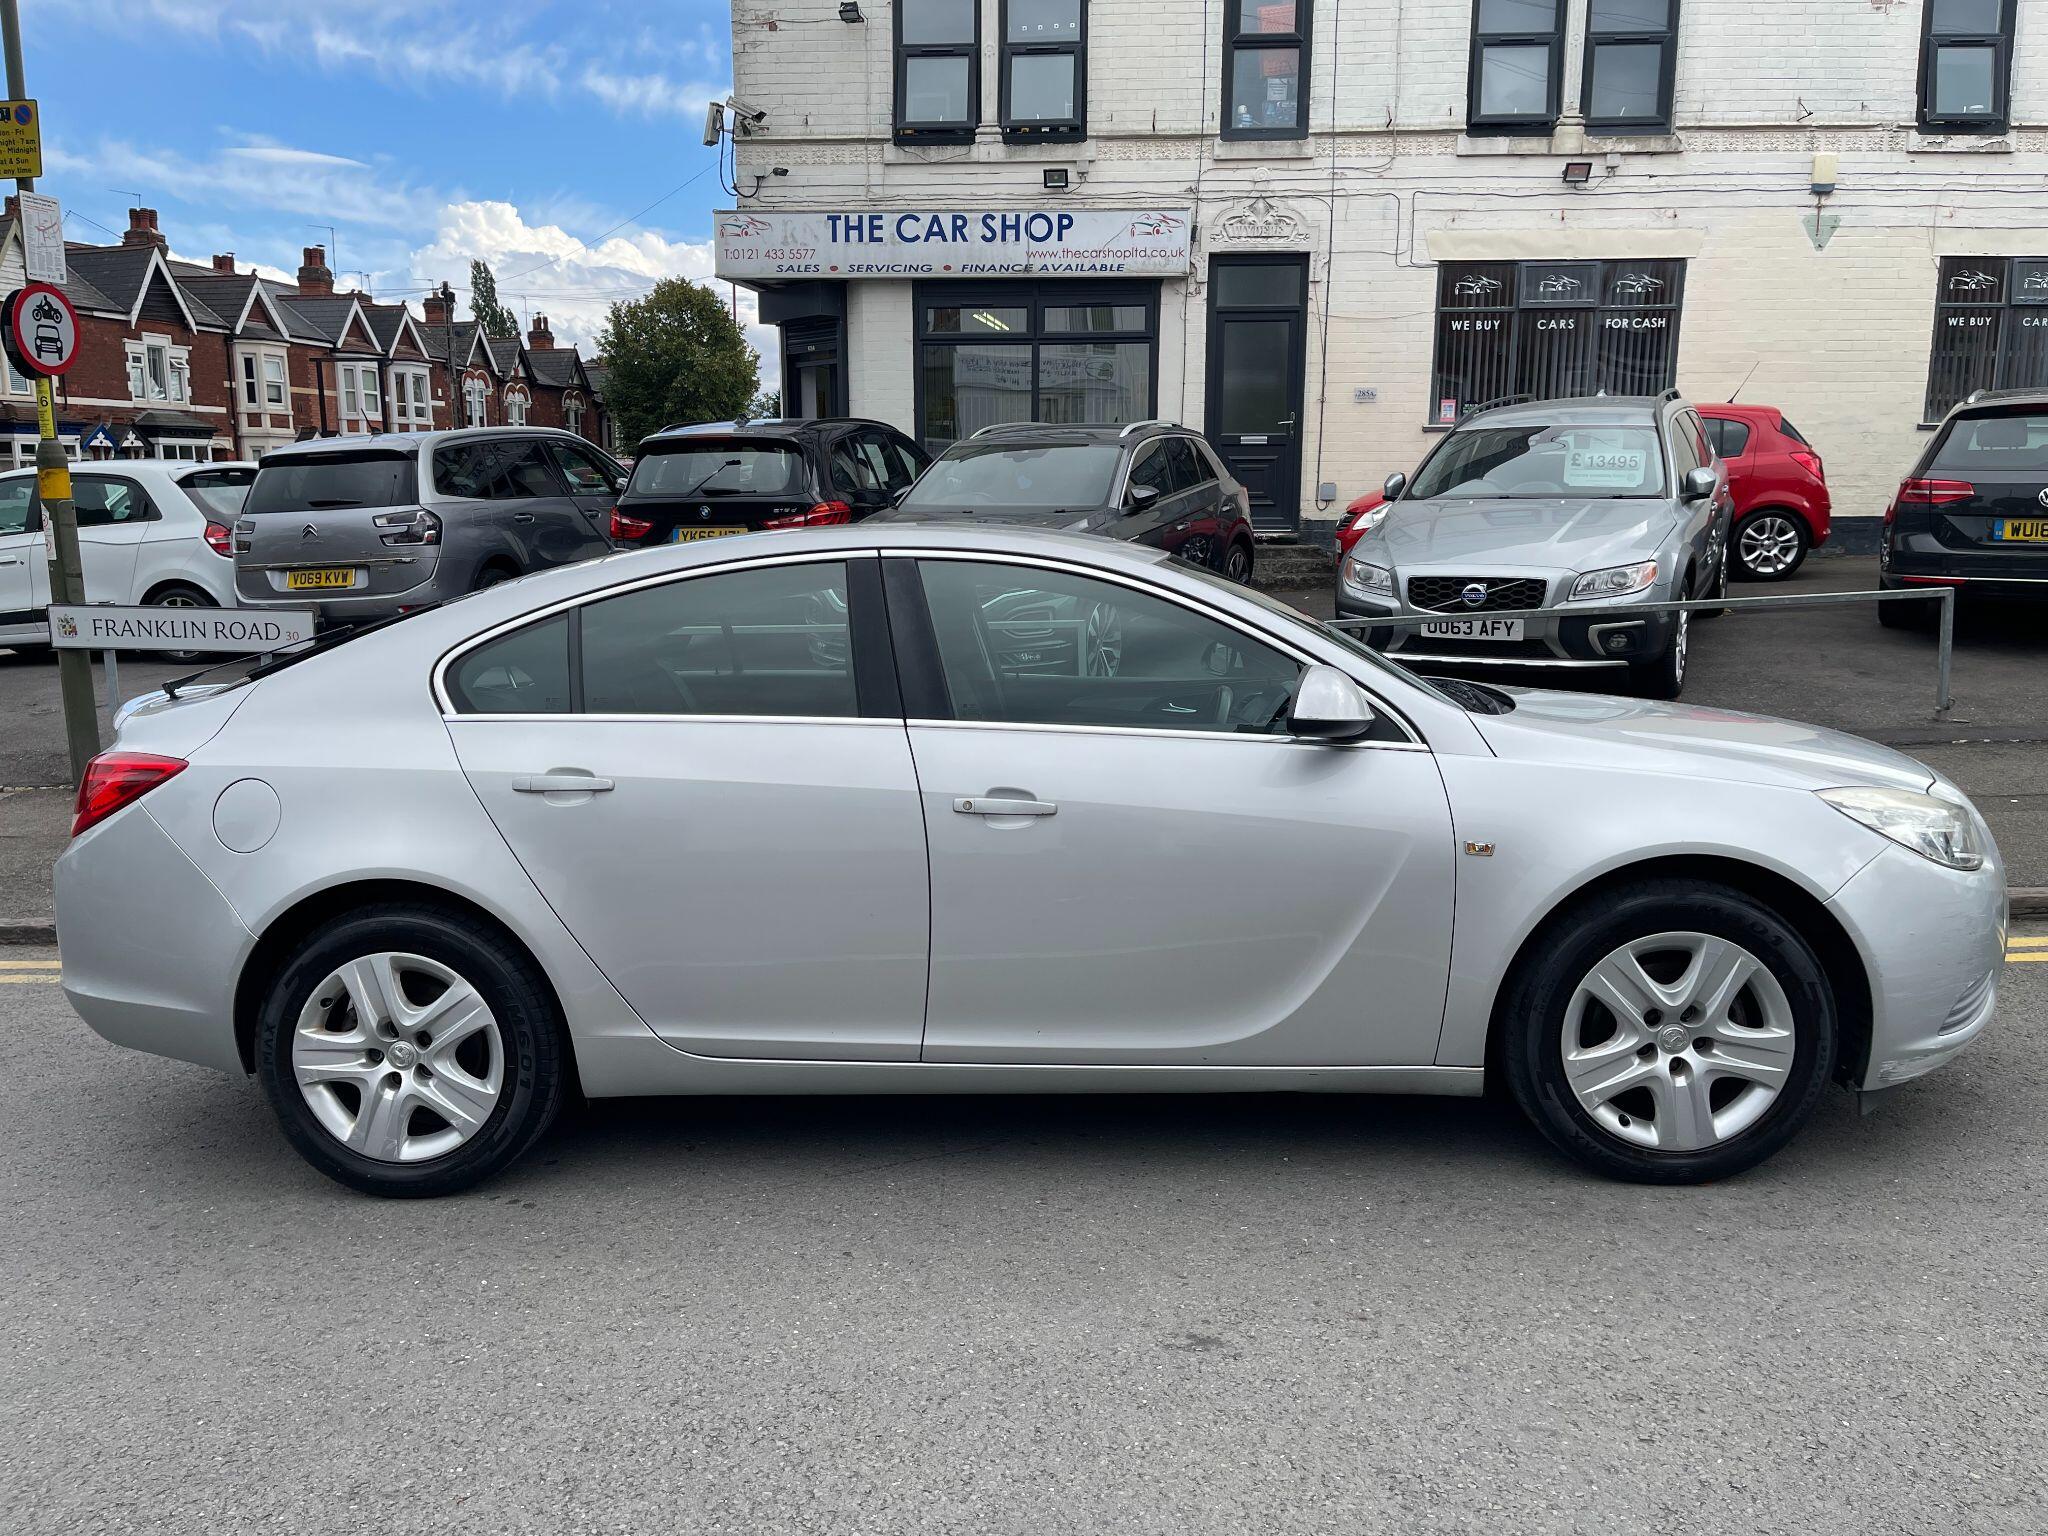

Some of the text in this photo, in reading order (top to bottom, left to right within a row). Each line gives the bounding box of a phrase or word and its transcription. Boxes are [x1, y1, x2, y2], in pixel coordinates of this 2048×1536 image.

[826, 214, 884, 243] THE
[896, 213, 968, 243] CAR
[980, 213, 1074, 243] SHOP
[724, 248, 816, 260] T:0121 433 5577
[1026, 247, 1185, 260] www.thecarshopltd.co.uk
[776, 263, 1125, 273] SALES SERVICING FINANCE AVAILABLE
[1451, 317, 1666, 330] WE BUY CARS FOR CASH
[1948, 317, 1965, 326] WE
[1969, 317, 1992, 326] BUY
[40, 395, 49, 407] 6
[1587, 455, 1638, 468] 13495
[325, 571, 349, 583] KVW
[92, 618, 300, 641] FRANKLIN ROAD 30
[1479, 620, 1515, 636] AFY
